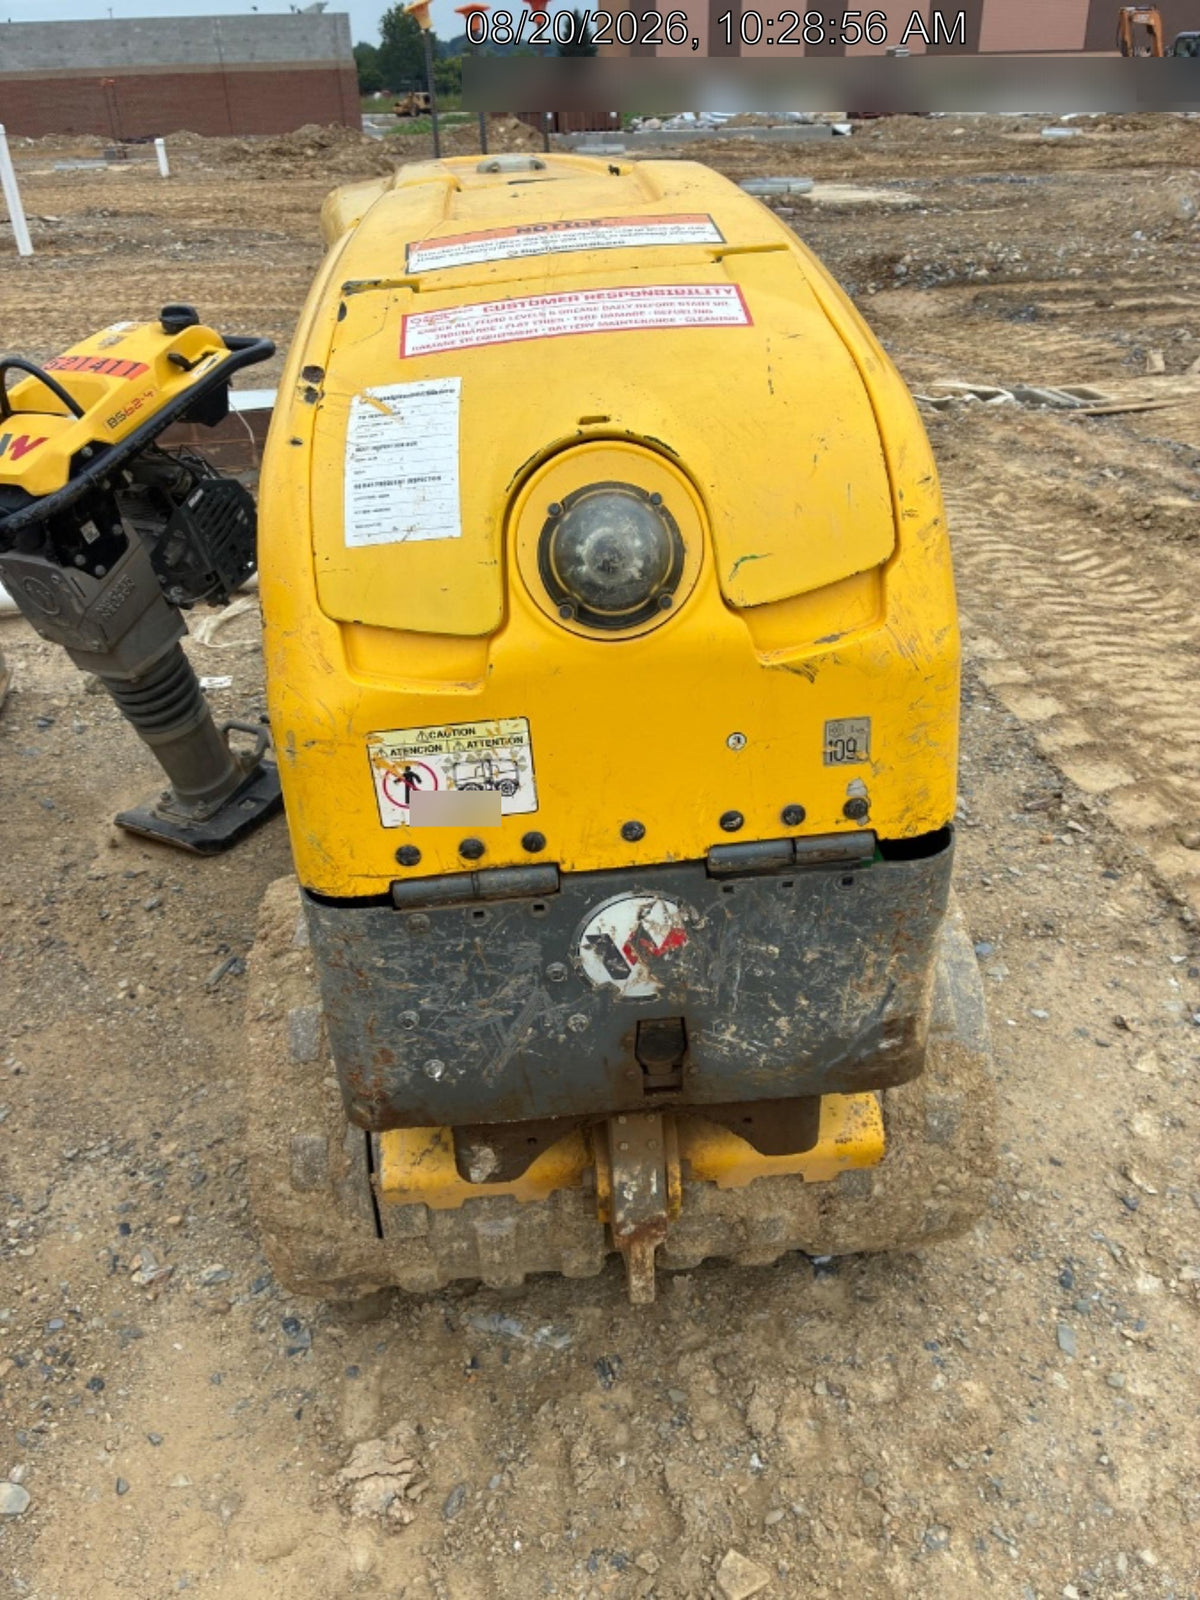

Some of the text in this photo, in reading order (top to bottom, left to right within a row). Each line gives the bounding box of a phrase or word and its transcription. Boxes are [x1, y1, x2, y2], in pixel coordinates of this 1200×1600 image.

[517, 219, 602, 233] NOTICE
[483, 287, 732, 313] CUSTOMER RESPONSIBILITY
[428, 727, 476, 740] CAUTION
[467, 736, 524, 750] ATTENTON
[828, 738, 857, 762] 109
